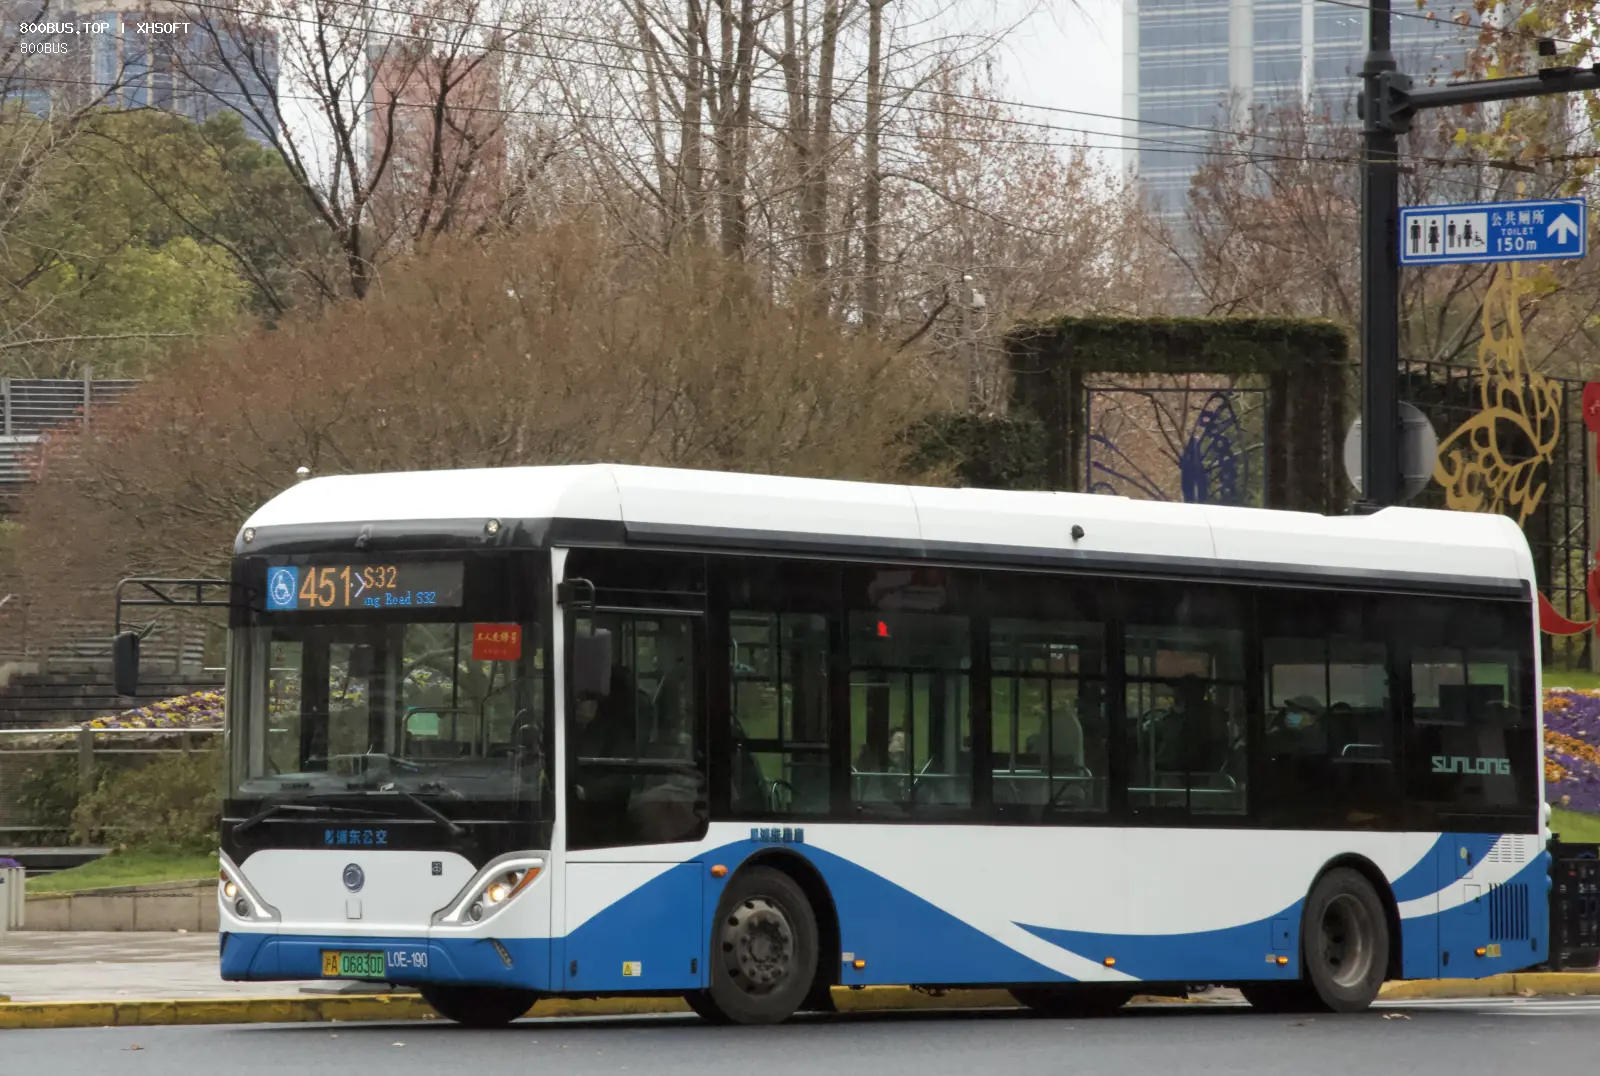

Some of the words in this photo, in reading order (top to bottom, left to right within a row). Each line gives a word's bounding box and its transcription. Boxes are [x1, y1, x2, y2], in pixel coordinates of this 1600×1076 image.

[1501, 227, 1534, 236] TOILET
[1497, 237, 1537, 252] 150m
[363, 566, 397, 588] S32
[299, 566, 351, 607] 451
[385, 590, 412, 605] Road
[416, 591, 436, 604] S32
[1431, 755, 1511, 775] SUNLONG
